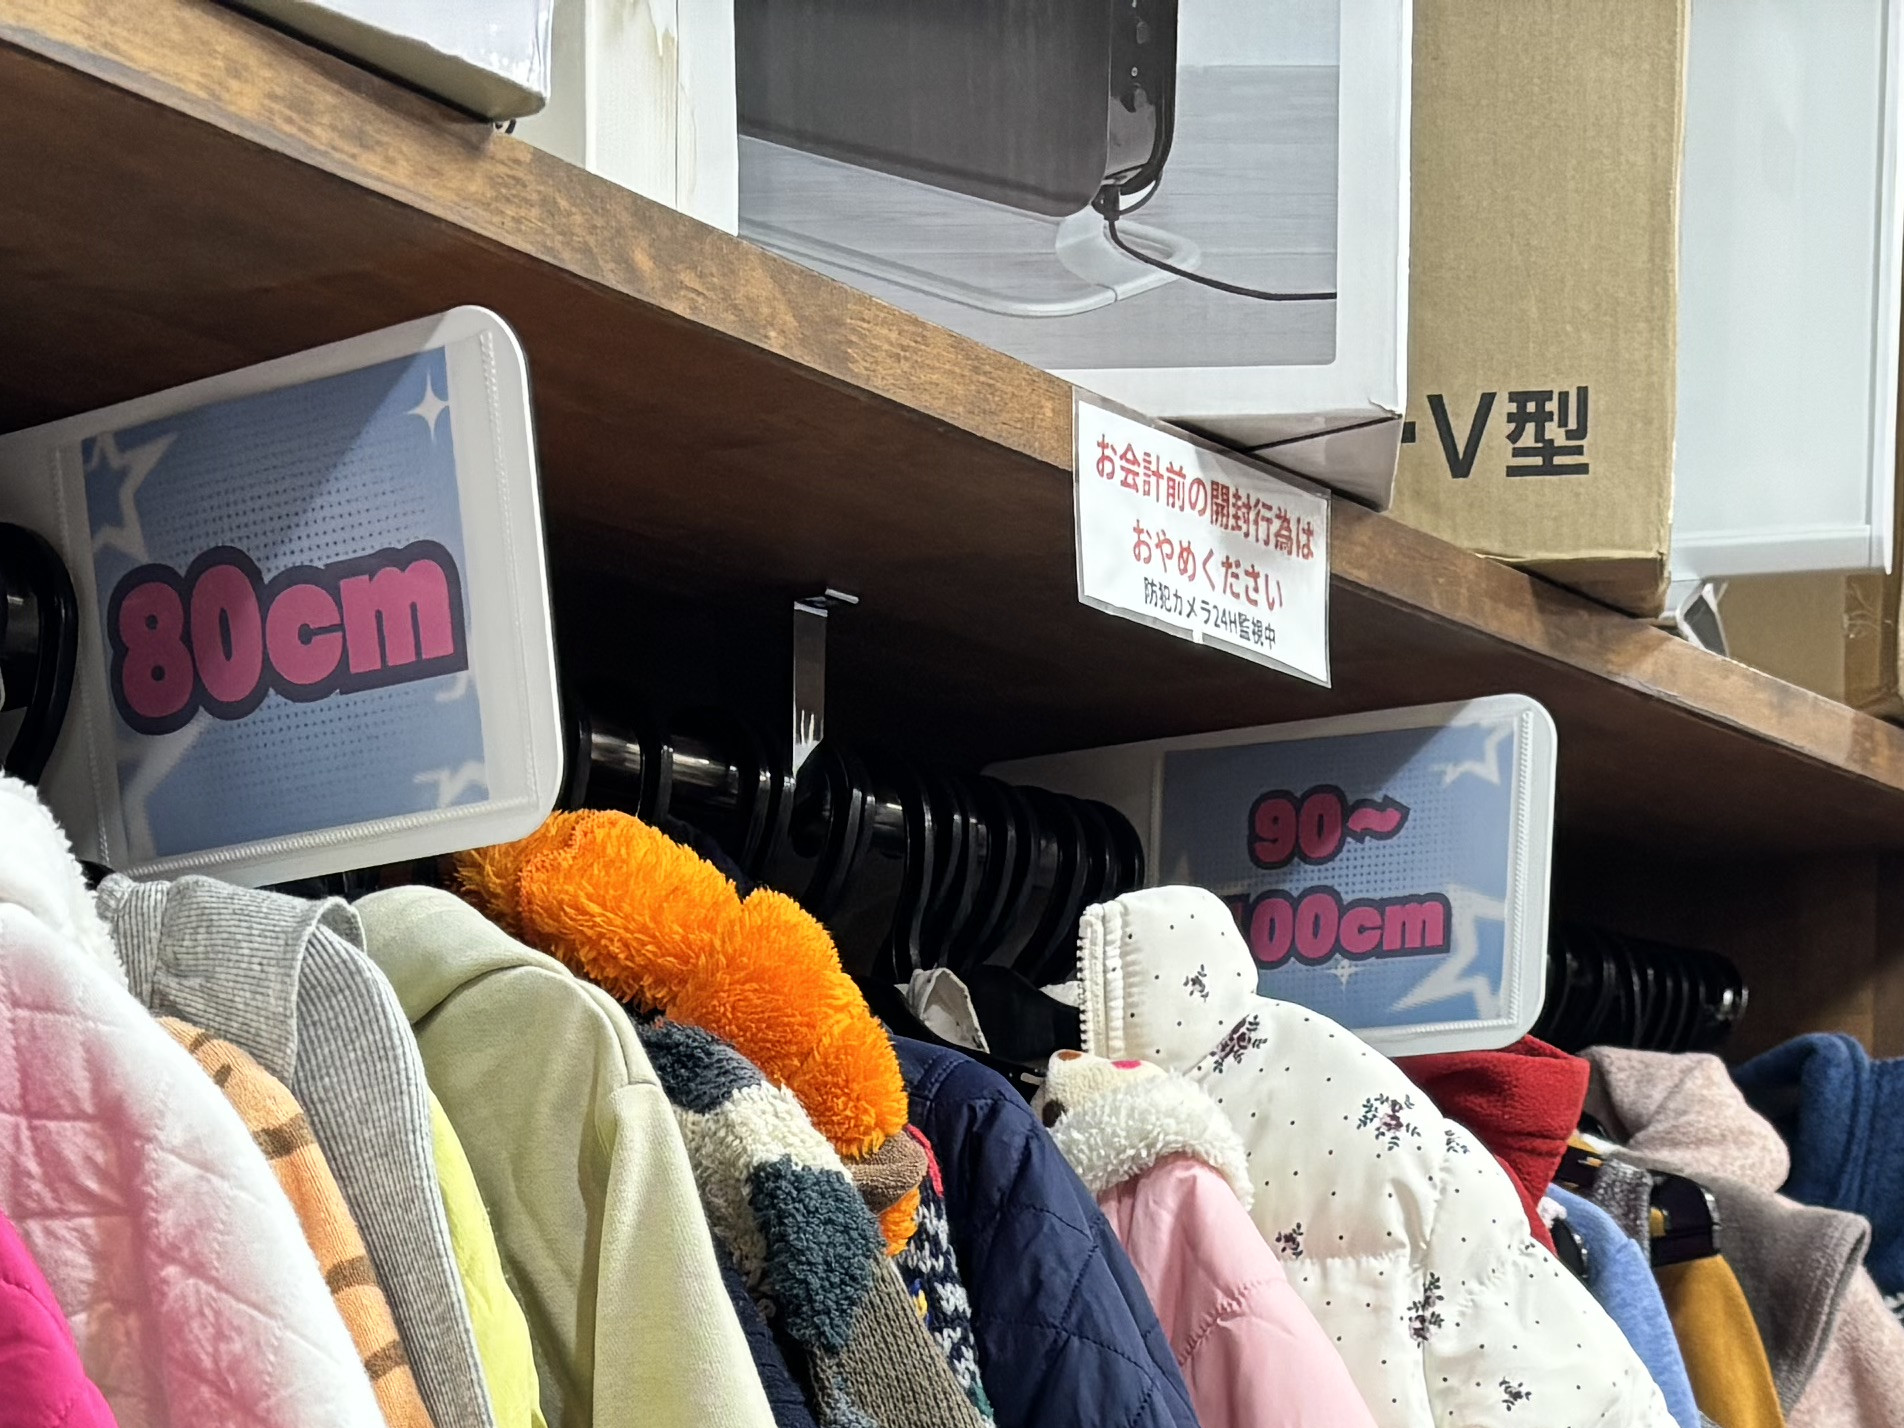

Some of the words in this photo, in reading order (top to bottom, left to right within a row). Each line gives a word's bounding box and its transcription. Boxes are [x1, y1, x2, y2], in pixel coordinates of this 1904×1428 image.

[1095, 433, 1315, 560] お会計前の開封行為は
[1132, 518, 1284, 612] おやめください
[110, 543, 468, 733] 80cm
[1143, 576, 1277, 650] 防犯カメラ24H監視中
[1249, 786, 1409, 869] 90~
